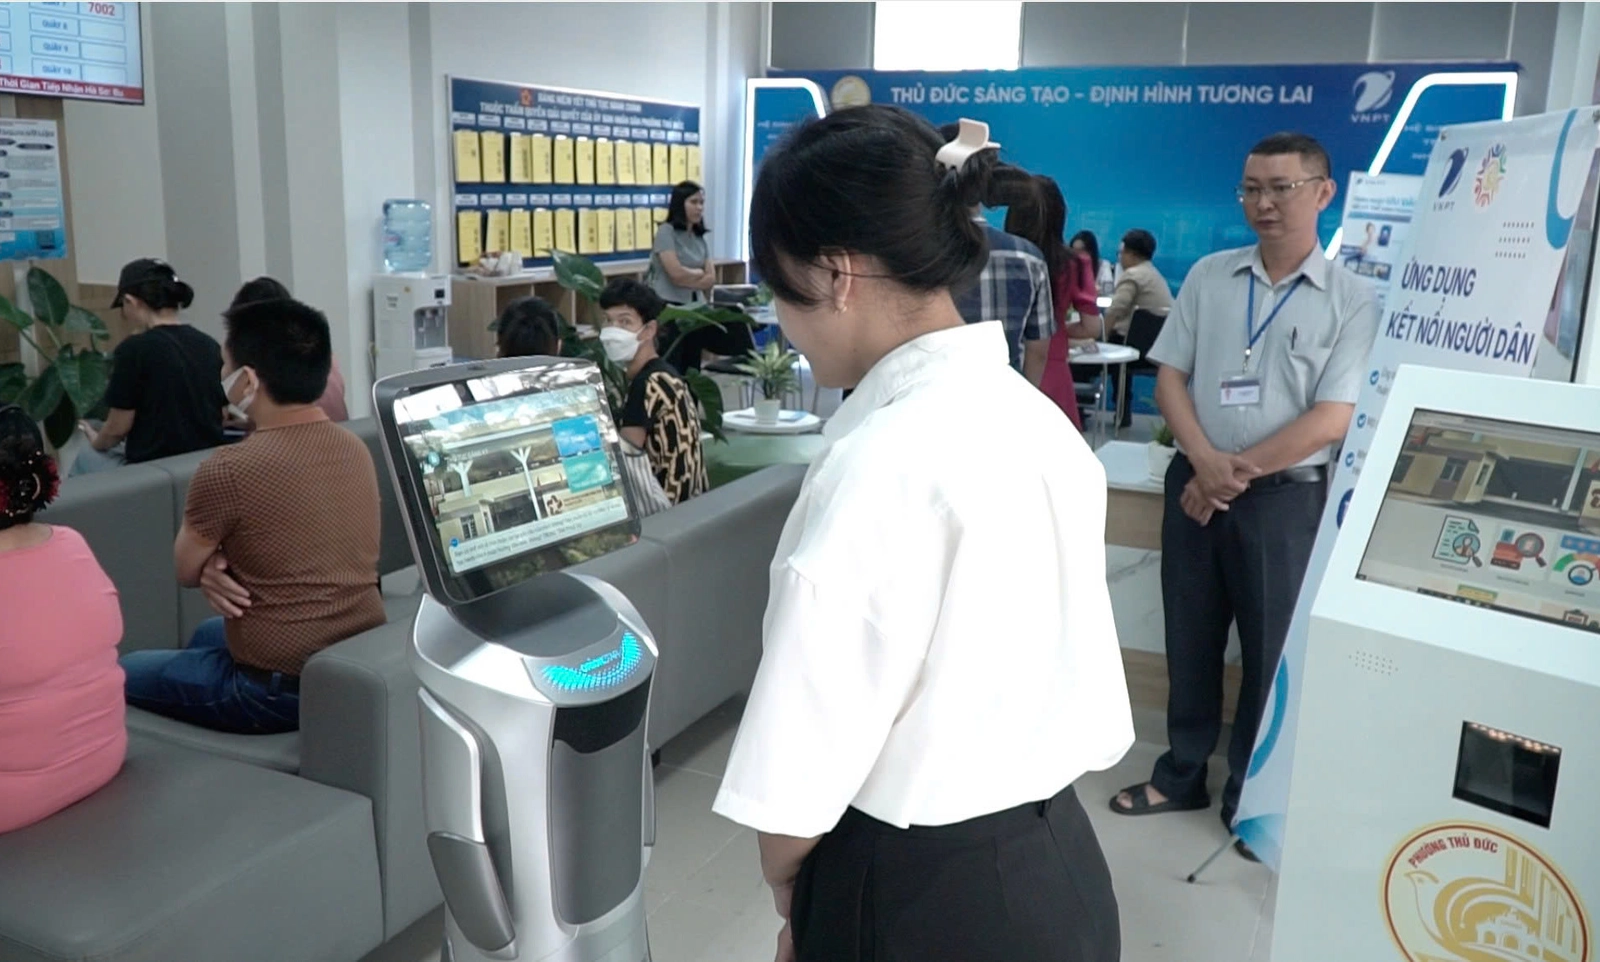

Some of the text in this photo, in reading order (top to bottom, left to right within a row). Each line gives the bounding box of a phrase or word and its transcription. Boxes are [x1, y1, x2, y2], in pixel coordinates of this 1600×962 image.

[88, 2, 115, 16] 7002
[20, 79, 40, 90] Gian
[891, 83, 925, 103] THỦ
[930, 84, 969, 104] ĐỨC
[974, 83, 1026, 104] SÁNG
[1032, 86, 1070, 107] TẠO
[1090, 86, 1138, 107] ĐỊNH
[1143, 82, 1192, 104] HÌNH
[1198, 84, 1274, 105] TƯƠNG
[1279, 85, 1313, 105] LAI
[1350, 113, 1391, 123] VNPT
[1433, 201, 1455, 212] VNPT
[1401, 258, 1477, 303] ỨNG DỤNG
[1386, 300, 1535, 365] KẾT NỐI NGƯỜI DÂN
[1408, 832, 1498, 868] PHƯỜNG THỦ ĐỨC
